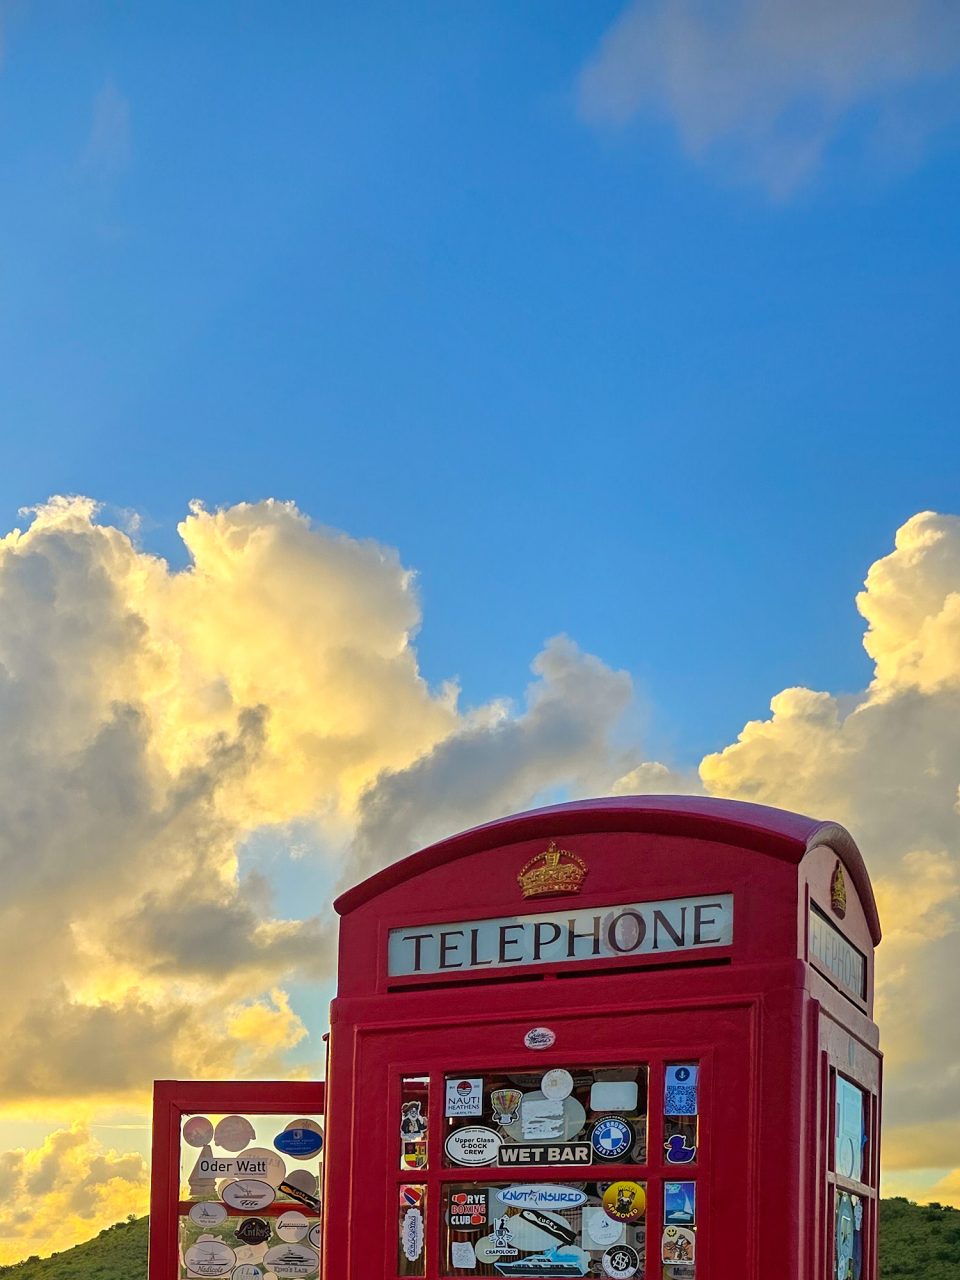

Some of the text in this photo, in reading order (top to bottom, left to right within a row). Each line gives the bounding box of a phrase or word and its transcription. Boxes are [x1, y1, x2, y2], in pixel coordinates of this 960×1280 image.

[402, 903, 724, 971] TELEPHONE
[448, 1096, 480, 1105] NAUTI
[500, 1146, 589, 1162] WET BAR
[200, 1160, 266, 1172] Oder Watt
[466, 1194, 486, 1204] RYE
[502, 1190, 581, 1202] KNOT INSURED
[450, 1204, 486, 1215] BOXING
[607, 1203, 638, 1219] APPROVED
[450, 1215, 471, 1225] CLUB
